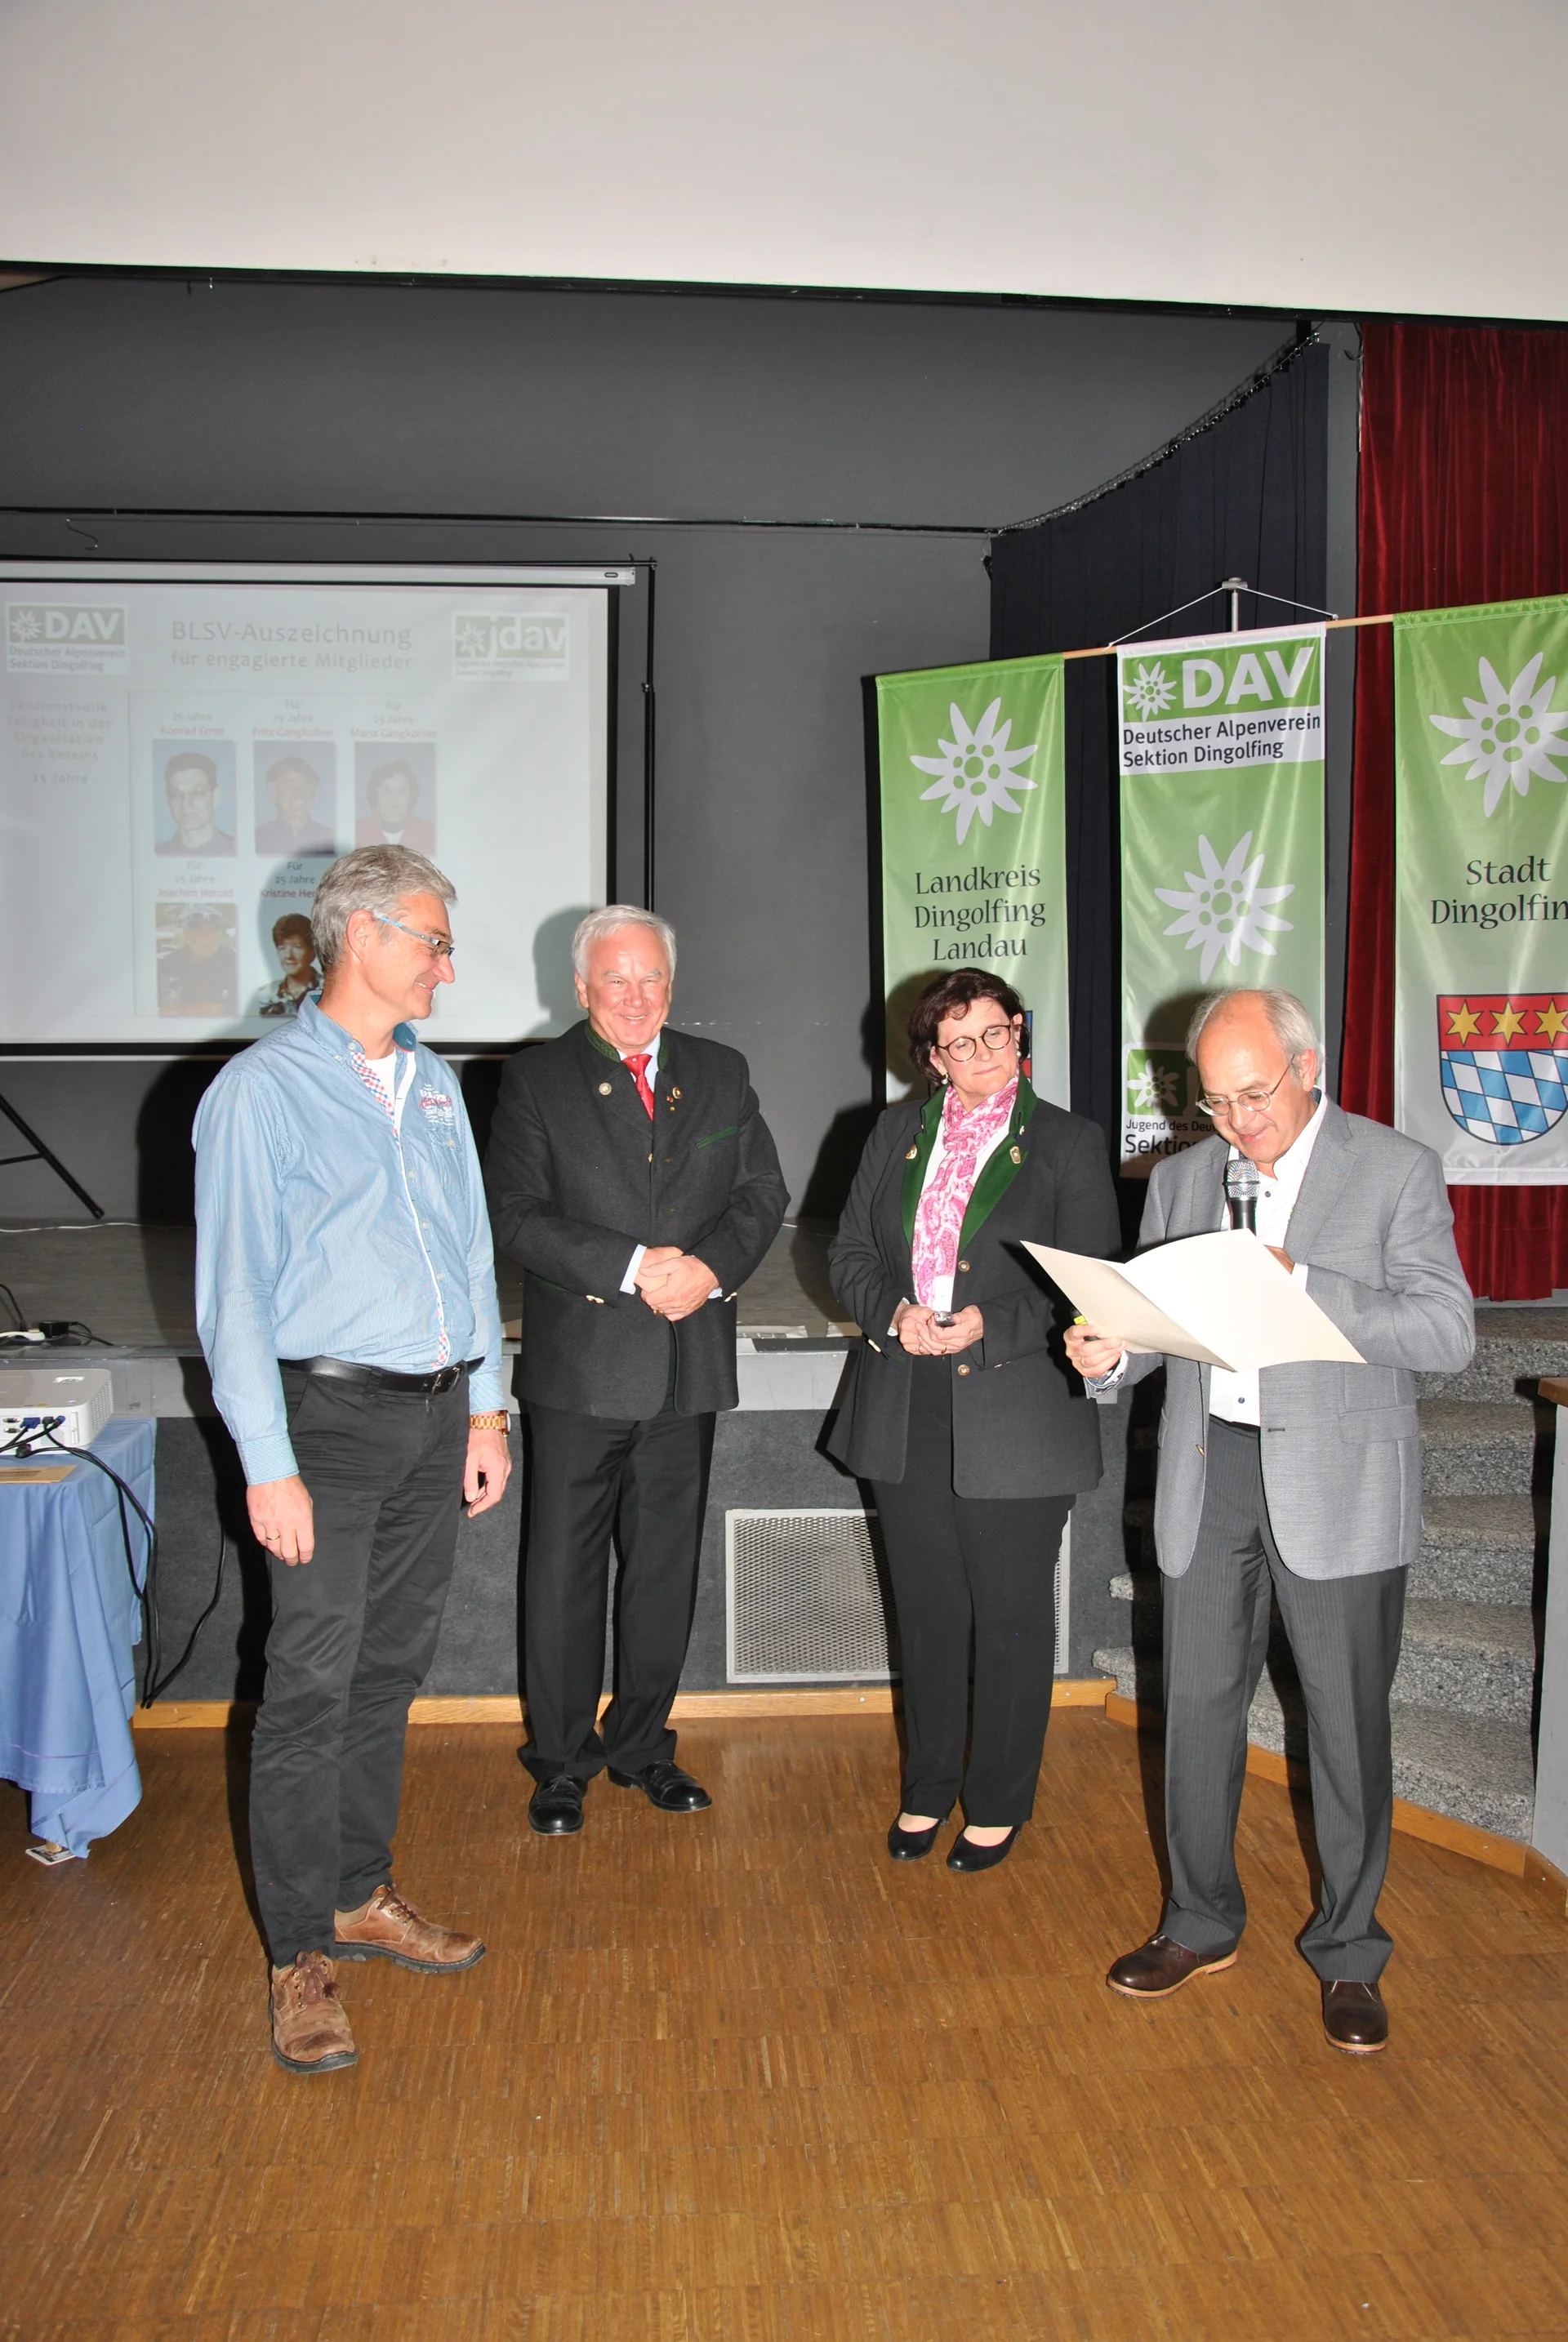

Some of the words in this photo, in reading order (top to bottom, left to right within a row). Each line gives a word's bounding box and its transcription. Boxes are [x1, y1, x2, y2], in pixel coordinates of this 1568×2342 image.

[46, 611, 120, 639] DAV
[172, 621, 412, 650] BLSV-Auszeichnung
[486, 615, 567, 660] jdav
[9, 646, 61, 657] Deutscher
[65, 648, 126, 659] Alpenverein
[9, 658, 49, 669] Sektion
[51, 660, 105, 672] Dingolfing
[171, 649, 198, 666] für
[206, 652, 309, 672] engagierte
[315, 652, 414, 674] Mitglieder
[1183, 646, 1314, 709] DAV
[1123, 724, 1211, 745] Deutscher
[1217, 713, 1321, 740] Alpenverein
[1123, 748, 1187, 767] Sektion
[1194, 740, 1284, 764] Dingolfing
[287, 862, 303, 870] Für
[915, 864, 1040, 894] Landkreis
[1466, 855, 1552, 885] Stadt
[275, 876, 286, 885] 25
[289, 875, 315, 884] Jahre
[915, 898, 1046, 932] Dingolfing
[1430, 893, 1568, 929] Dingolfin
[933, 933, 1027, 960] Landau
[1126, 1119, 1165, 1132] Jugend
[1169, 1120, 1188, 1131] des
[1125, 1133, 1197, 1155] Sektio
